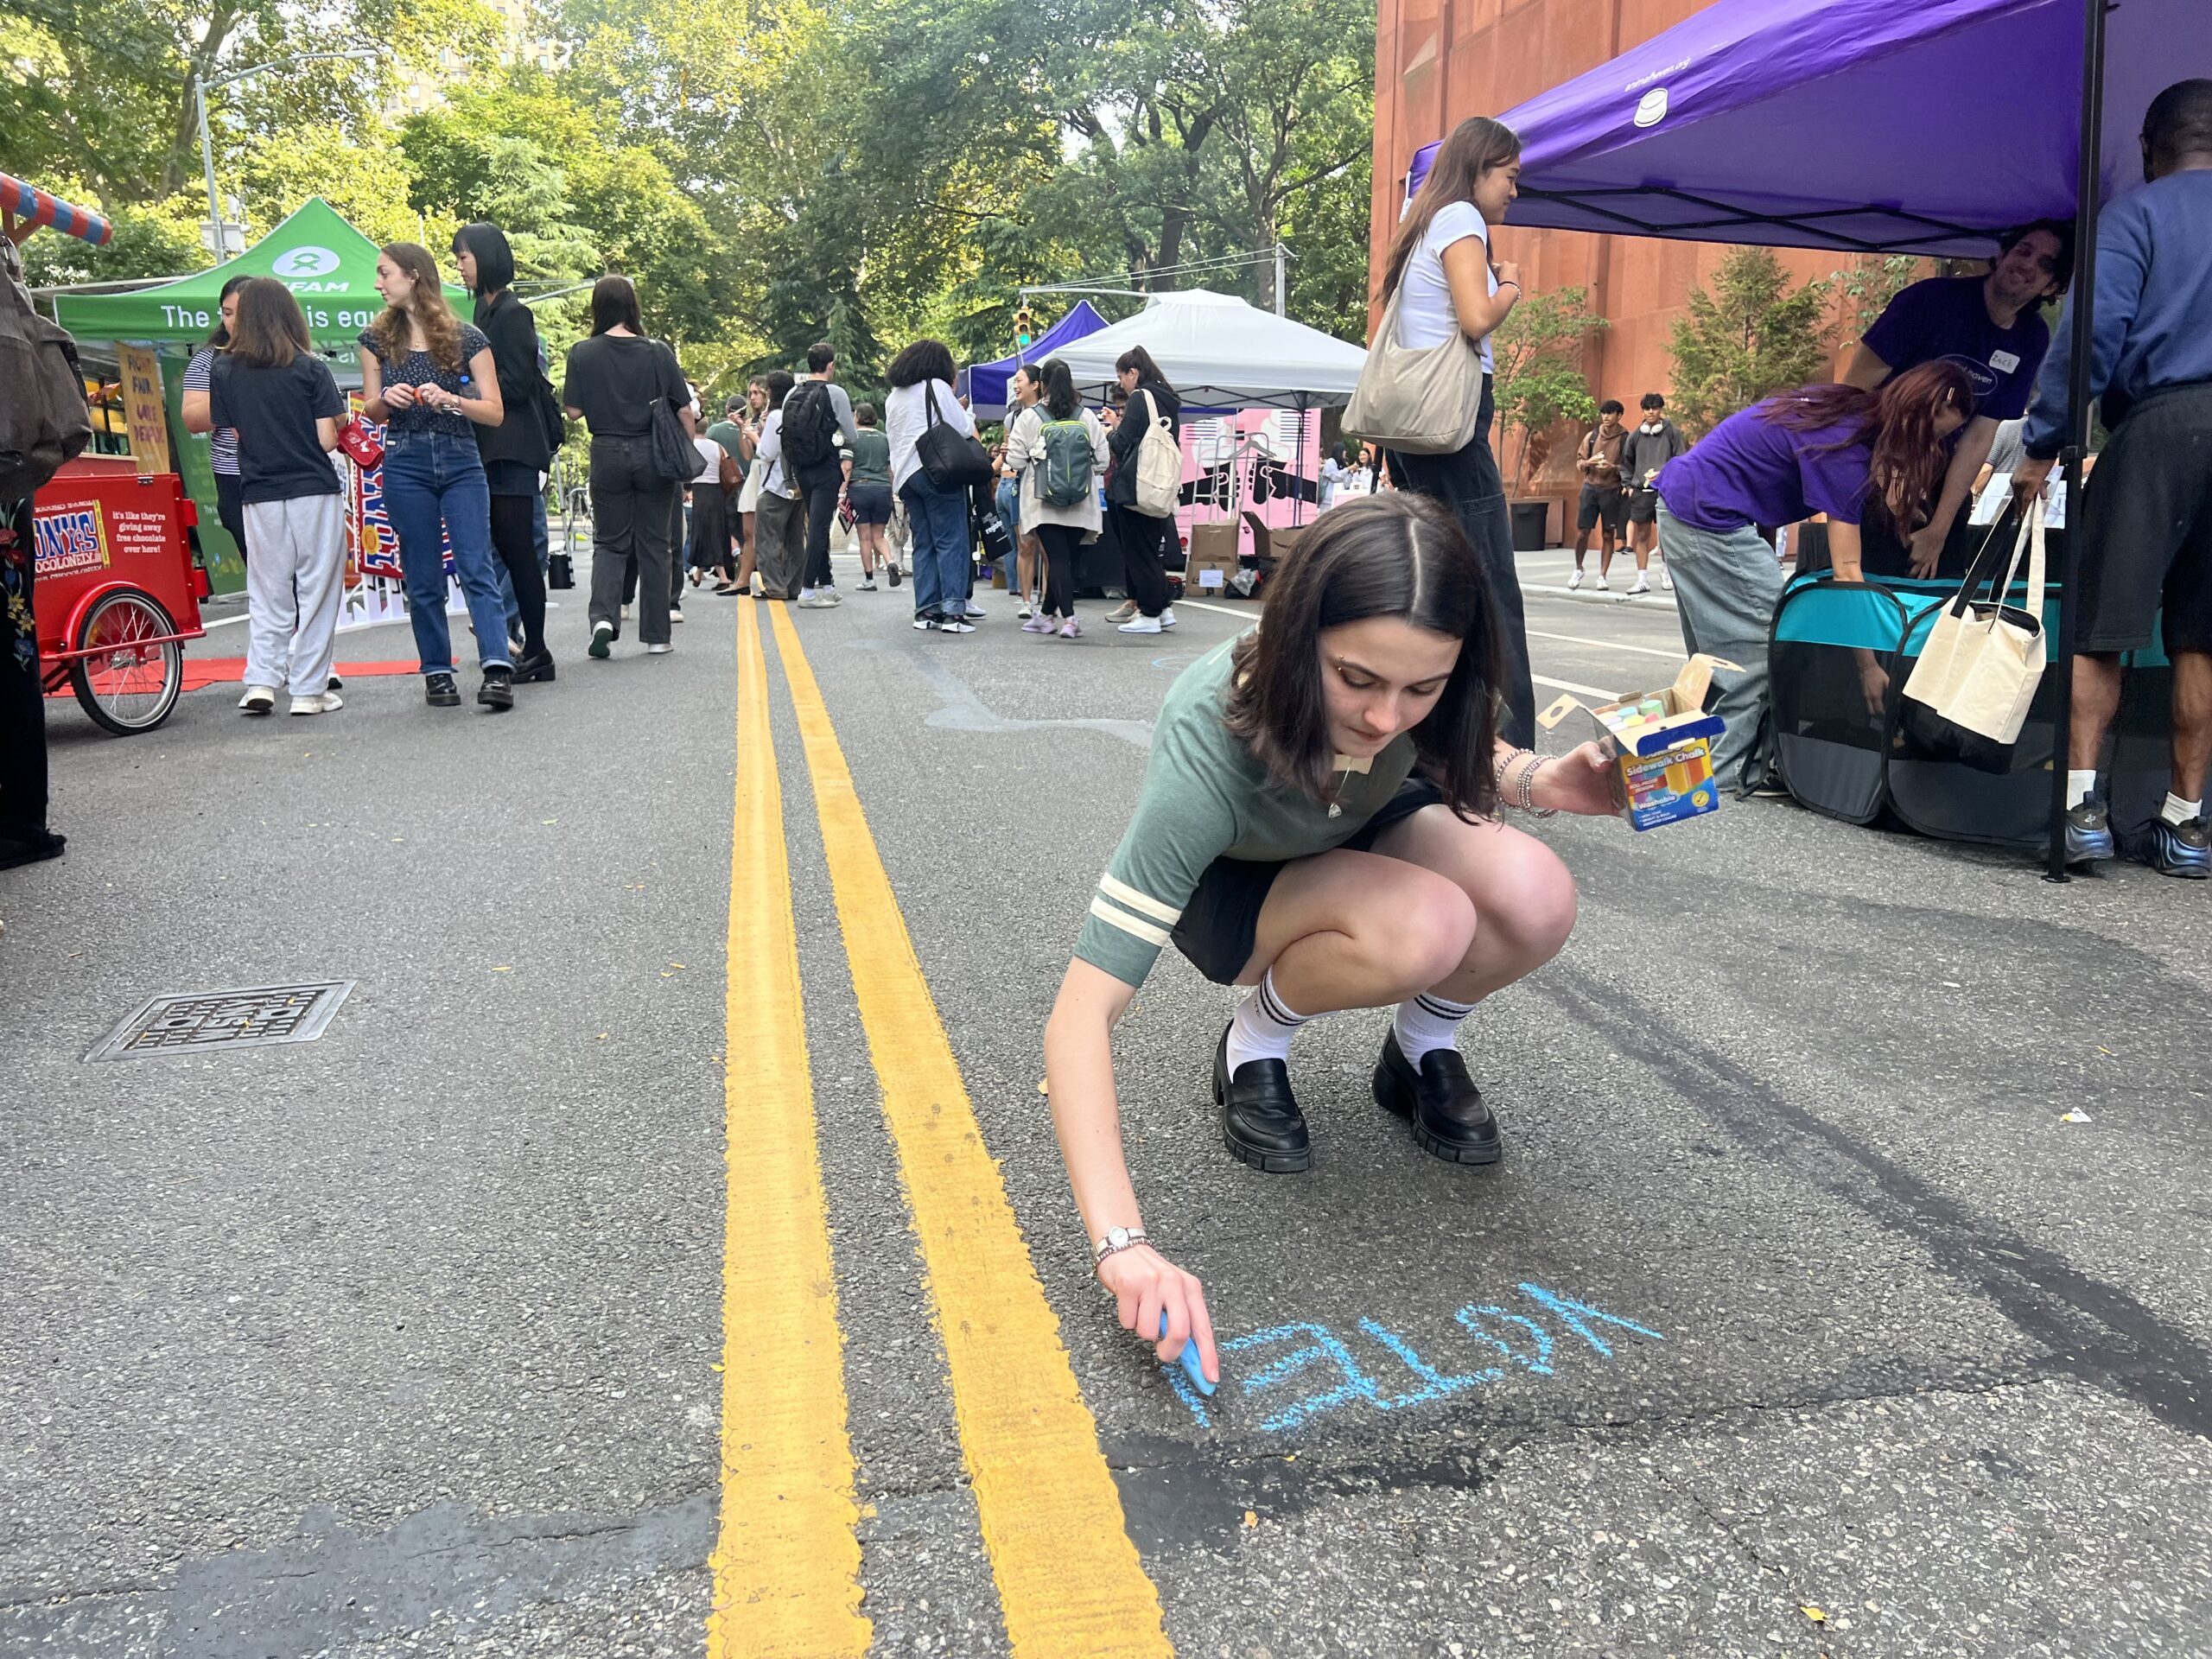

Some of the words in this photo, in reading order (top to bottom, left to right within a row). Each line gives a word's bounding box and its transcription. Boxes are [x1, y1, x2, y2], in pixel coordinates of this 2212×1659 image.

[283, 282, 350, 292] FAM
[161, 305, 210, 328] The
[307, 305, 329, 327] is
[1991, 353, 2013, 369] Zach
[125, 512, 139, 520] like
[119, 522, 142, 532] giving
[143, 524, 162, 533] away
[33, 510, 99, 562] ONY'S
[117, 533, 131, 543] free
[132, 534, 166, 543] chocolate
[142, 544, 161, 553] here!
[35, 551, 93, 574] OCOLONELY
[1626, 757, 1674, 777] Sidewalk
[1675, 747, 1705, 763] Chalk
[1638, 795, 1676, 810] Washable
